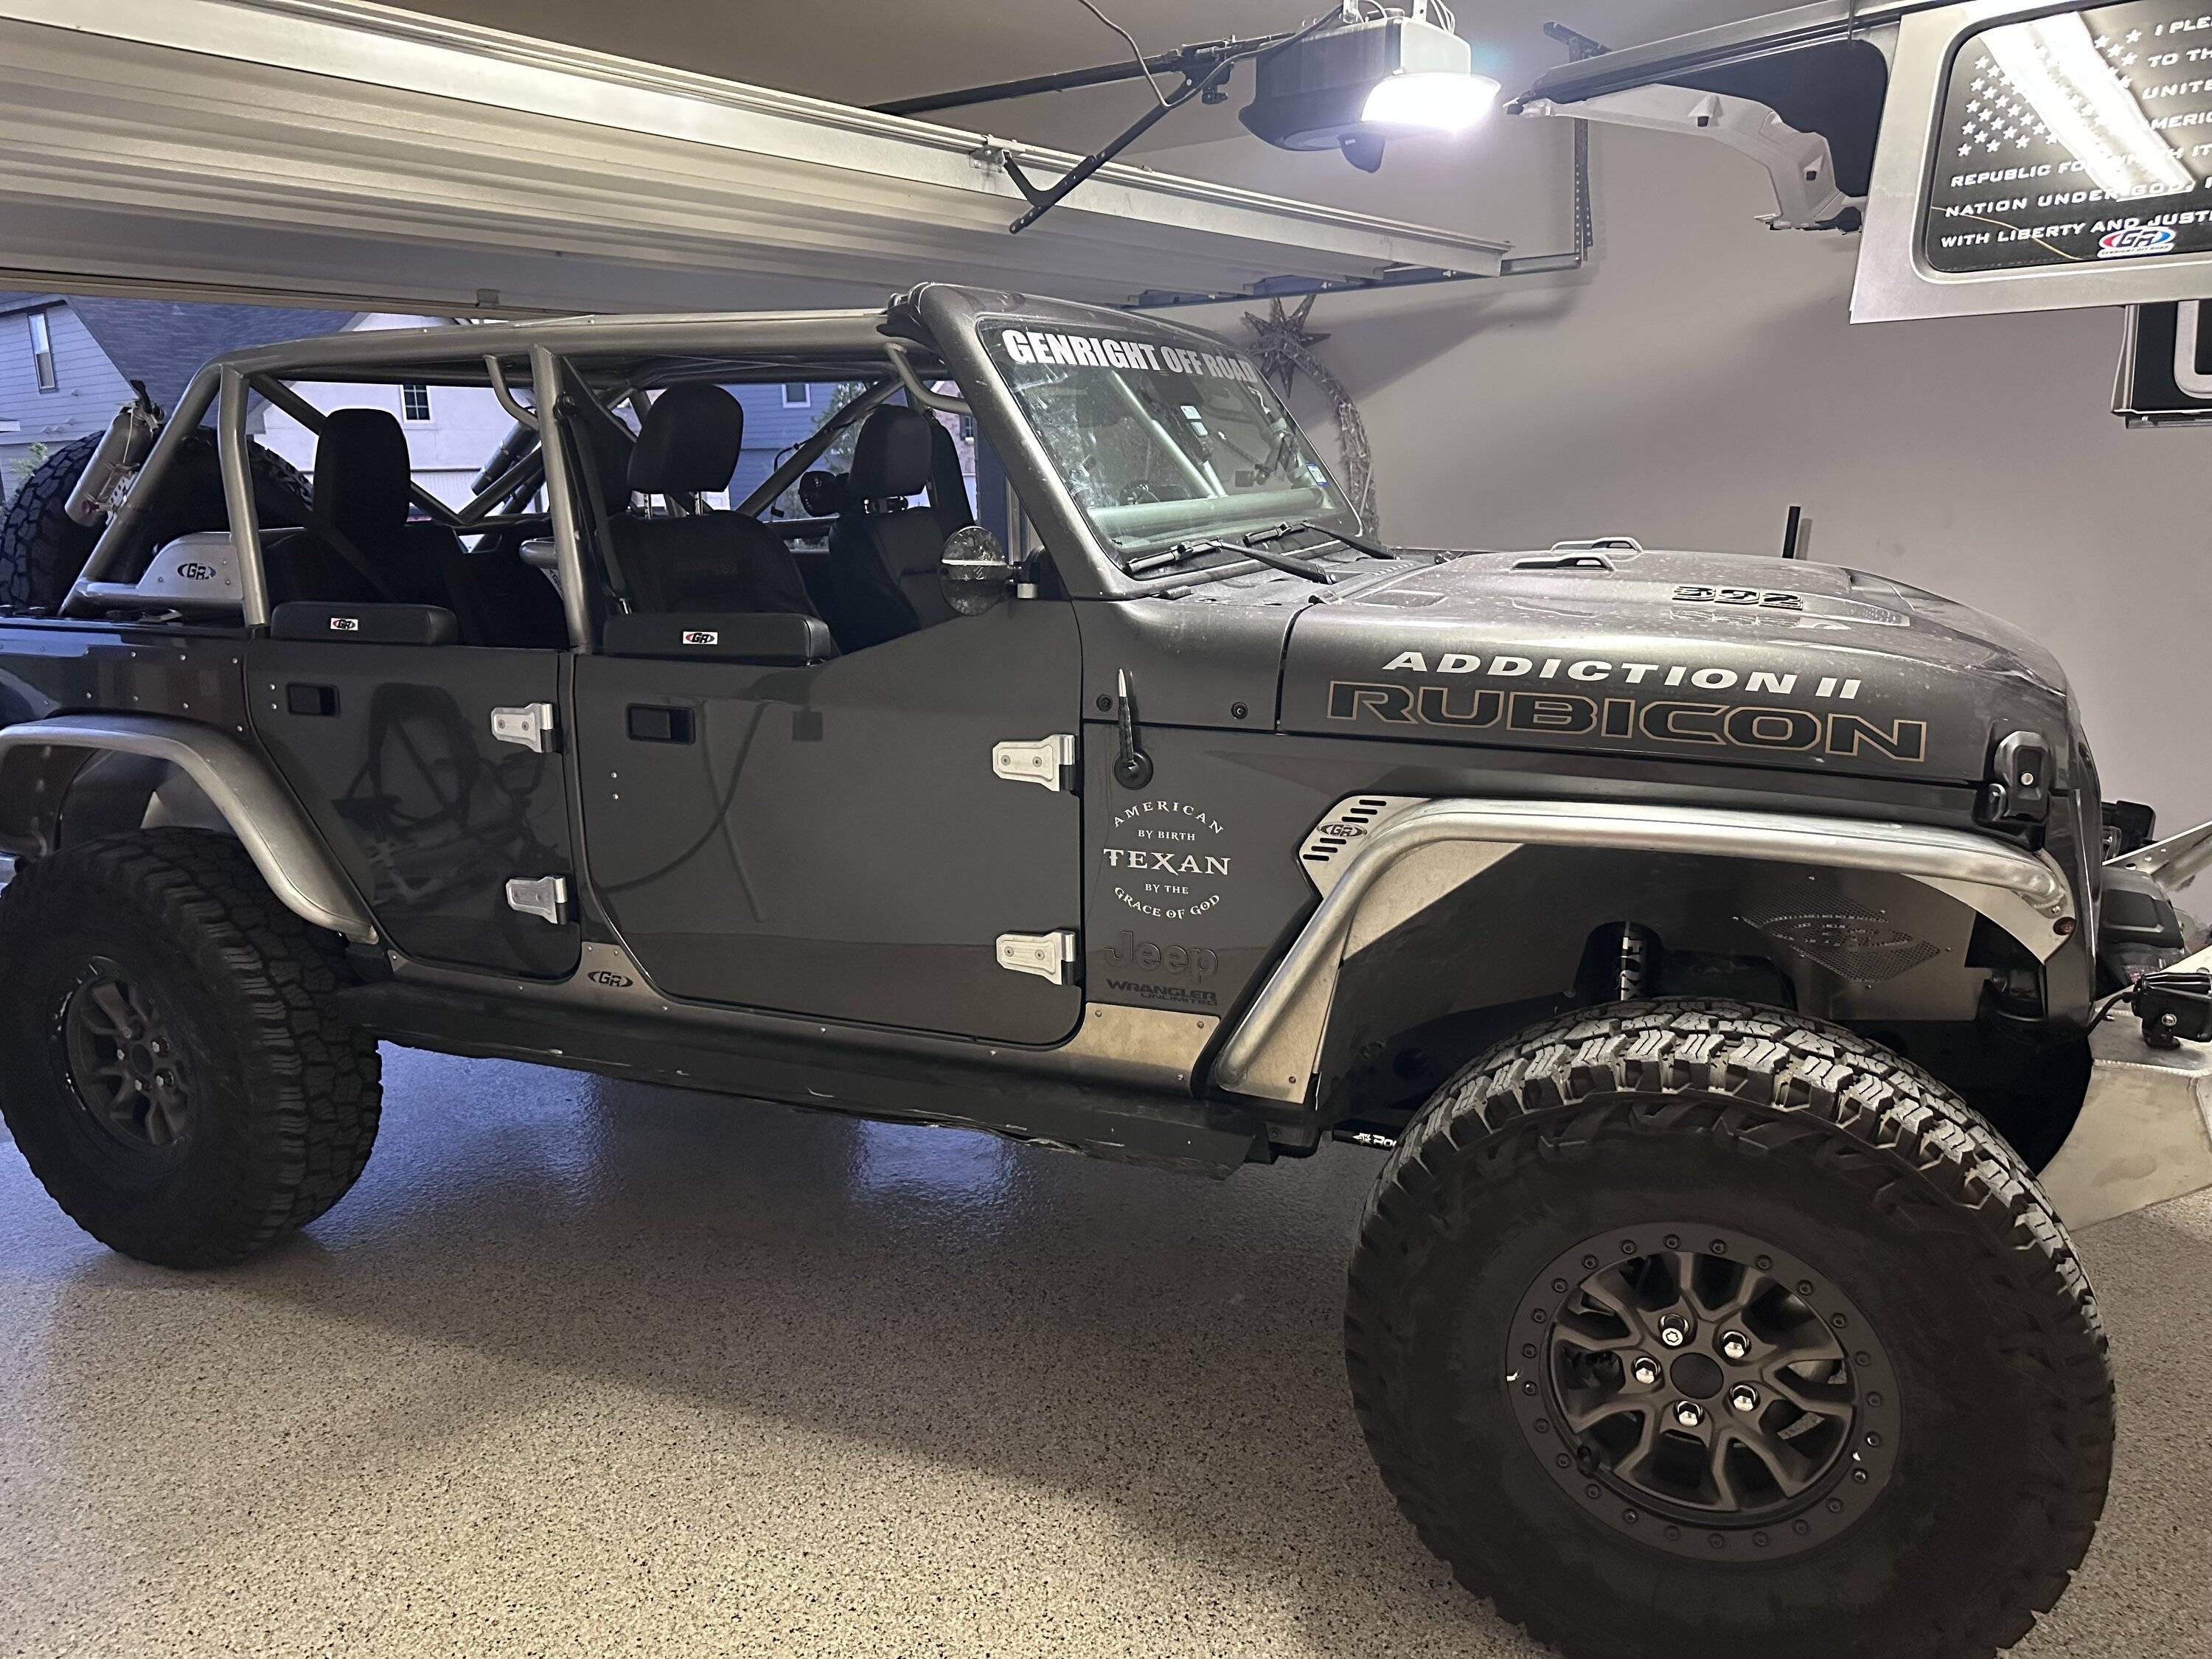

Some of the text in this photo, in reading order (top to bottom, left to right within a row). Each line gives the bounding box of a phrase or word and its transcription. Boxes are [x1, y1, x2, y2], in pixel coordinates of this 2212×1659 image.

[2154, 16, 2212, 36] I PLE
[2147, 52, 2179, 68] TO
[1950, 159, 2088, 187] REPUBLIC FO
[1944, 197, 2028, 218] NATION
[2037, 189, 2118, 207] UNDER
[1941, 232, 1990, 248] WITH
[1997, 222, 2086, 243] LIBERTY
[2090, 218, 2140, 234] AND
[1001, 329, 1259, 383] GENRIGHT OFF ROAD
[1672, 586, 1804, 611] 392
[1382, 651, 1863, 700] ADDICTION II
[1327, 681, 1927, 762] RUBICON
[1113, 801, 1224, 834] AMERICAN
[1138, 830, 1196, 841] BY BIRTH
[1103, 848, 1231, 876] TEXAN
[1145, 883, 1189, 894] BY THE
[1114, 887, 1220, 920] GRACE OF GOD
[1105, 931, 1219, 985] Jeep
[1105, 978, 1217, 1001] WRANGLER
